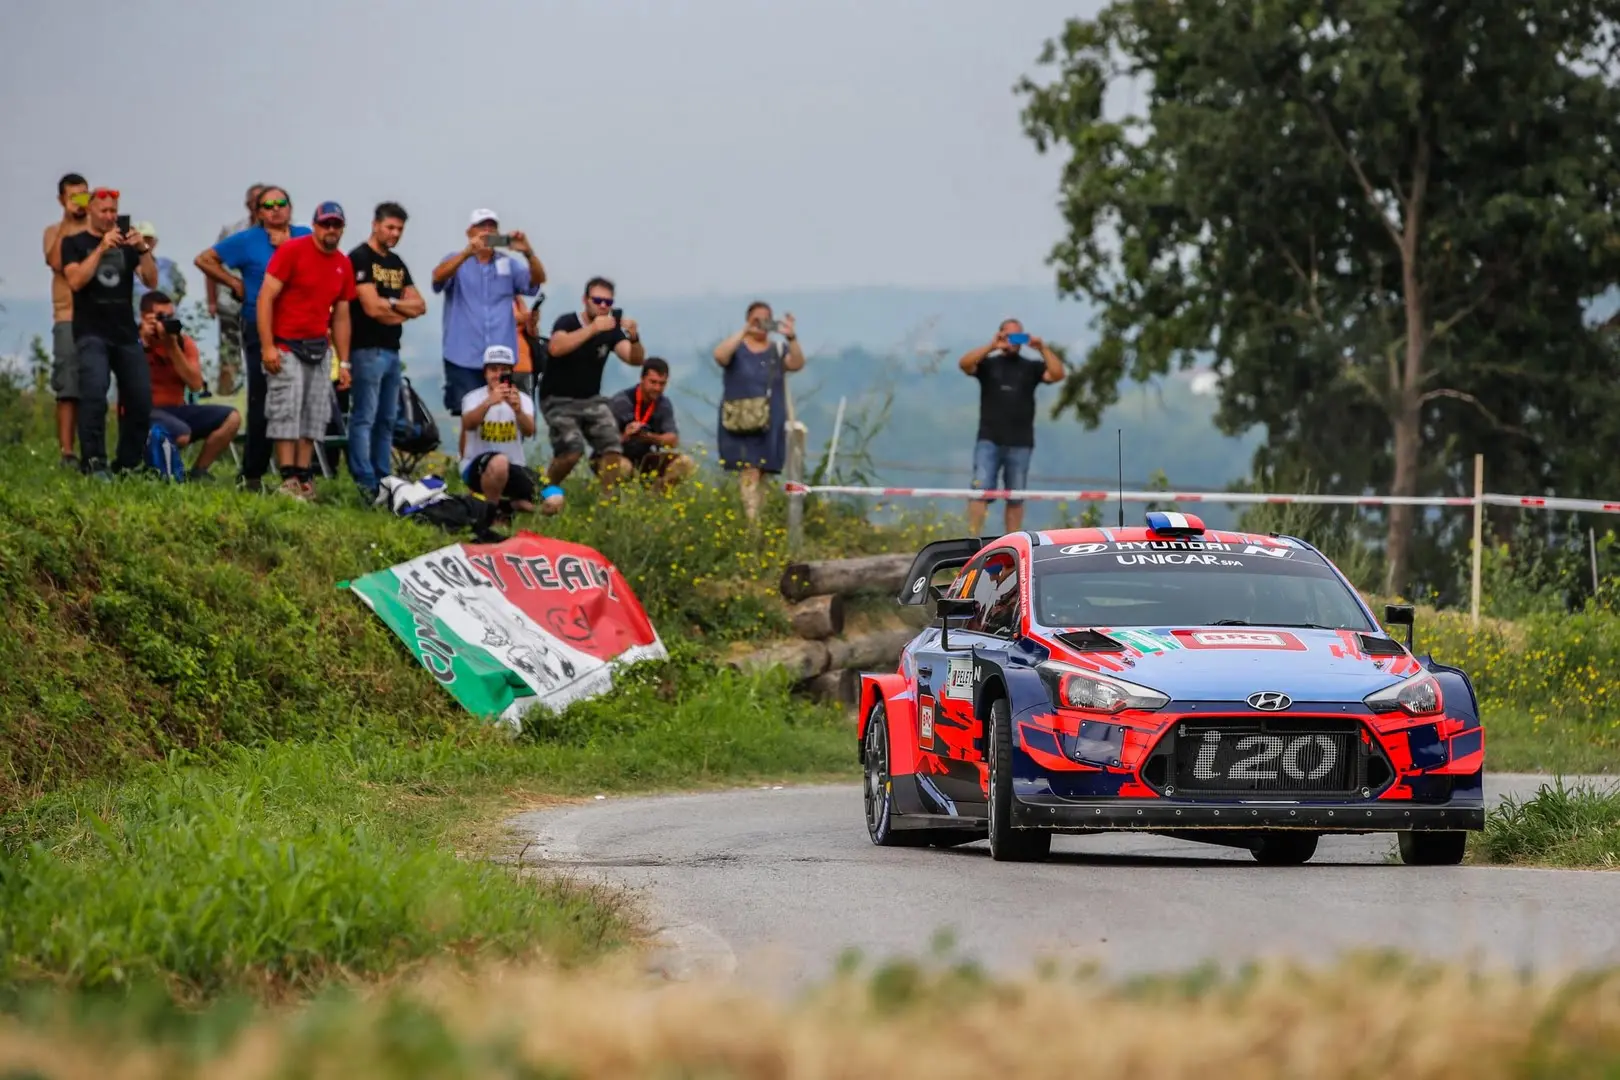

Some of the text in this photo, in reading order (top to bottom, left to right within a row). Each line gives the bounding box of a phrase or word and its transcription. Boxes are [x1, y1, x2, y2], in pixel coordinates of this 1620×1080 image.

[1115, 541, 1232, 551] HYUNDAI
[1116, 554, 1220, 566] UNICAR
[1203, 633, 1272, 641] BRC
[1193, 731, 1337, 780] i20
